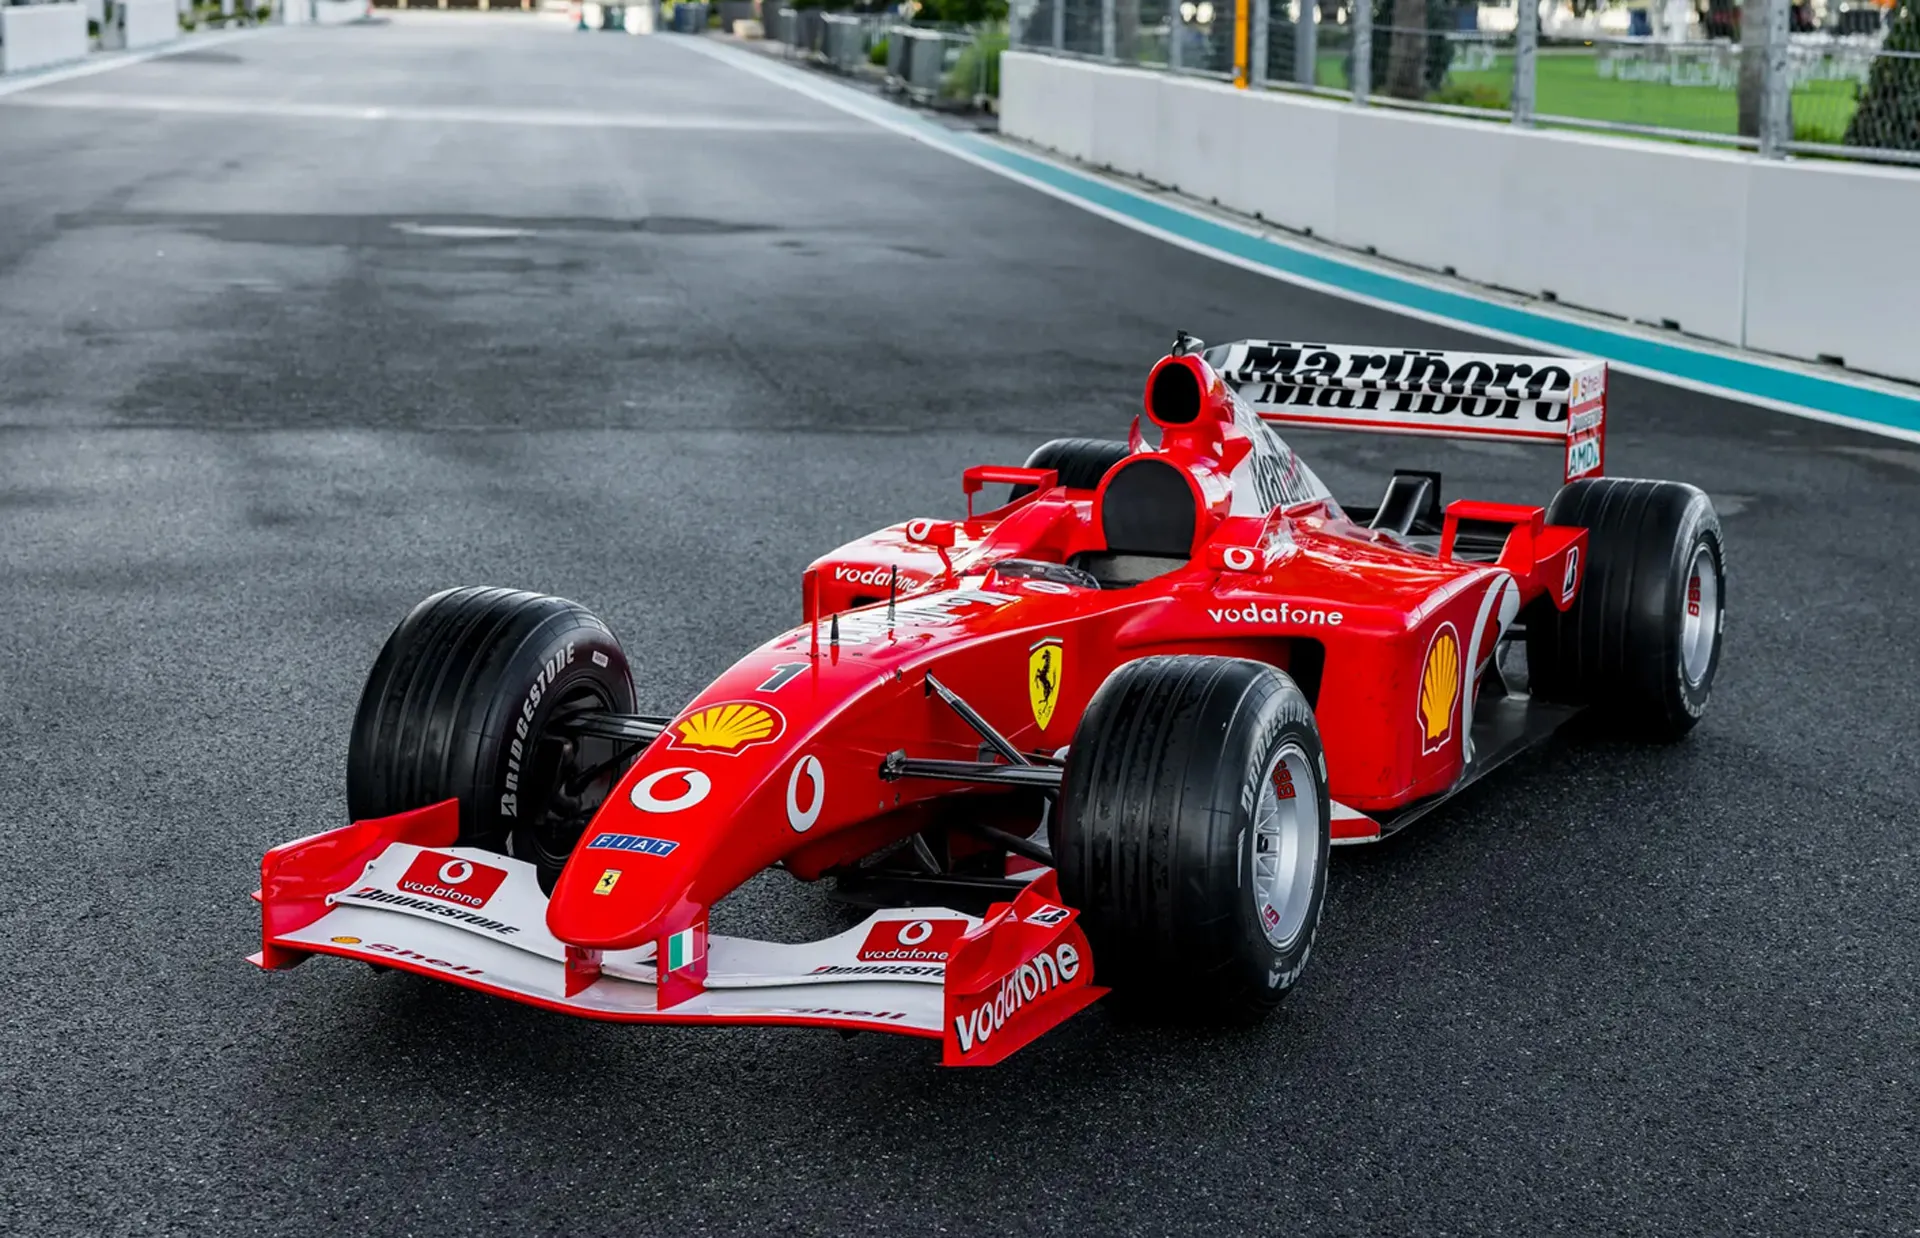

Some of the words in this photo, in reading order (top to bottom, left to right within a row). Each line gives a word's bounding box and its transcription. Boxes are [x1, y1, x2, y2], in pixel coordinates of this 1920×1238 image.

[1238, 343, 1571, 399] Marlboro
[1207, 602, 1343, 626] vodafone
[755, 662, 813, 692] 1
[501, 641, 575, 817] BRIDGESTONE
[1272, 759, 1297, 800] BBS
[594, 834, 674, 855] FIAT
[403, 880, 483, 907] vodafone
[350, 887, 521, 936] BRIDGESTONE
[365, 943, 484, 976] Shell
[863, 948, 949, 960] vodafone
[806, 965, 945, 978] BRIDGESTO
[954, 943, 1080, 1052] vodafone
